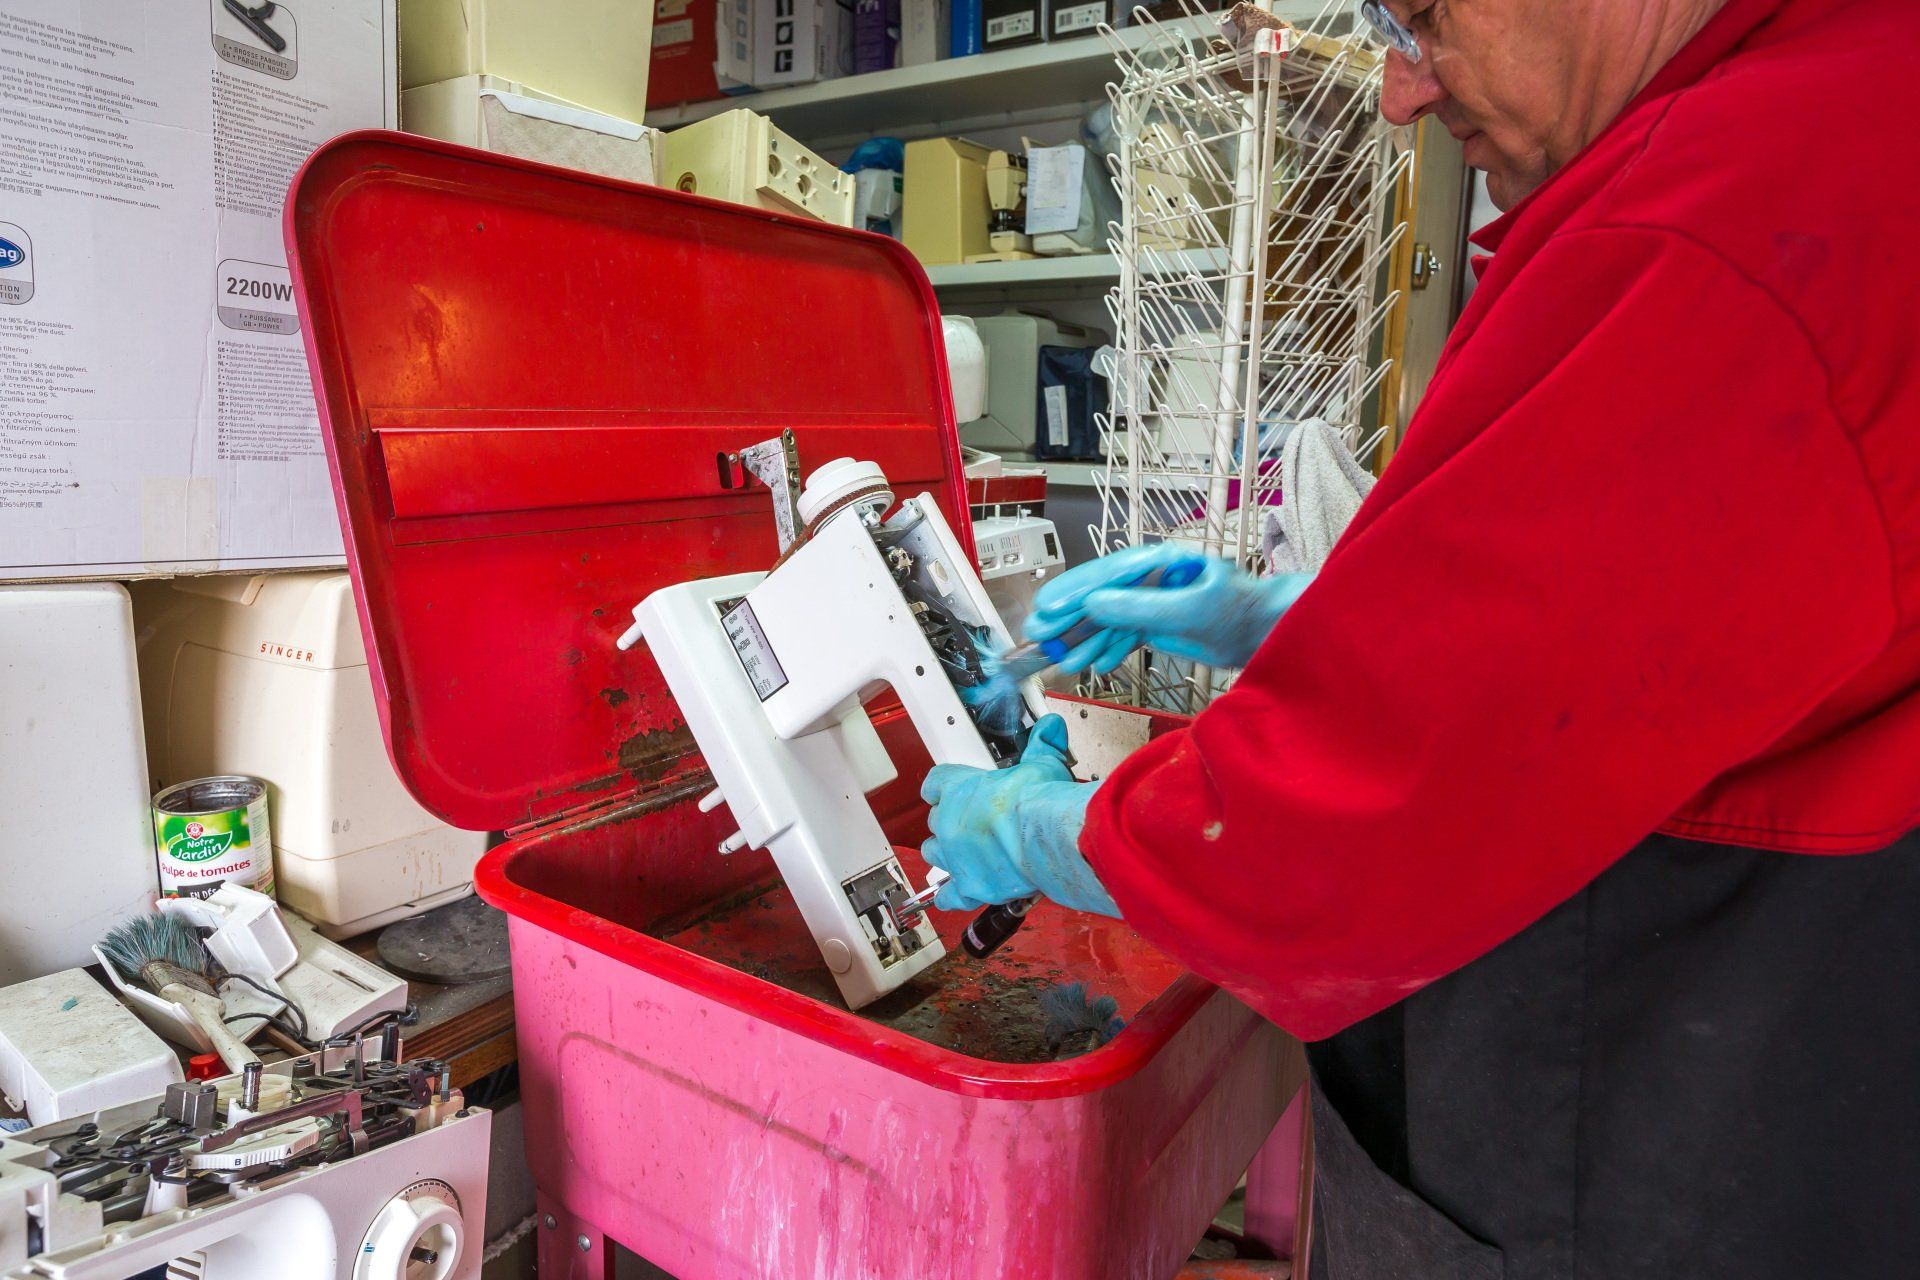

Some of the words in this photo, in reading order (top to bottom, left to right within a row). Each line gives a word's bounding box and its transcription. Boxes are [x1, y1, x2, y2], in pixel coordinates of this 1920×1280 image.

[13, 24, 29, 33] dust
[31, 27, 36, 35] in
[39, 32, 57, 42] every
[60, 36, 76, 45] nook
[79, 40, 94, 49] and
[92, 45, 116, 57] cranny.
[26, 35, 39, 44] den
[41, 39, 61, 49] Staub
[63, 45, 82, 56] selbst
[47, 25, 64, 34] dans
[78, 33, 107, 46] moindres
[109, 41, 134, 53] recoins.
[1, 47, 23, 56] wordt
[25, 51, 35, 60] het
[38, 55, 50, 64] stof
[61, 62, 73, 70] alle
[74, 65, 98, 76] hoeken
[100, 72, 135, 86] moeiteloos
[234, 47, 258, 59] BROSSE
[260, 56, 287, 69] PARQUET
[238, 56, 266, 69] PARQUET
[267, 65, 289, 76] NOZZLE
[2, 74, 22, 84] polvo
[35, 80, 44, 88] los
[47, 84, 76, 96] rincones
[78, 90, 91, 99] más
[26, 70, 52, 82] polvere
[54, 77, 75, 87] anche
[77, 82, 93, 92] negli
[95, 87, 120, 97] angolini
[121, 92, 130, 101] più
[132, 96, 160, 108] nascosti.
[33, 98, 62, 110] насадка
[64, 105, 104, 118] улавливает
[49, 93, 79, 105] recantos
[81, 99, 96, 109] mais
[28, 113, 52, 124] tozlara
[54, 118, 66, 127] bile
[39, 141, 58, 151] prach
[59, 153, 78, 163] prach
[20, 162, 41, 172] zbiera
[42, 167, 57, 175] kurz
[66, 171, 112, 186] najmniejszych
[227, 277, 293, 302] 2200W
[37, 321, 74, 330] poussières.
[249, 315, 282, 324] PUISSANCE
[3, 346, 28, 354] filtering
[48, 384, 96, 395] фильтрации:
[260, 643, 312, 662] SINGER
[174, 842, 222, 860] Jardin
[187, 837, 214, 848] Notre
[162, 863, 185, 878] Pulpe
[187, 870, 198, 878] de
[200, 860, 251, 877] tomates
[190, 890, 201, 900] EN
[286, 1148, 292, 1156] A
[186, 1158, 192, 1166] C
